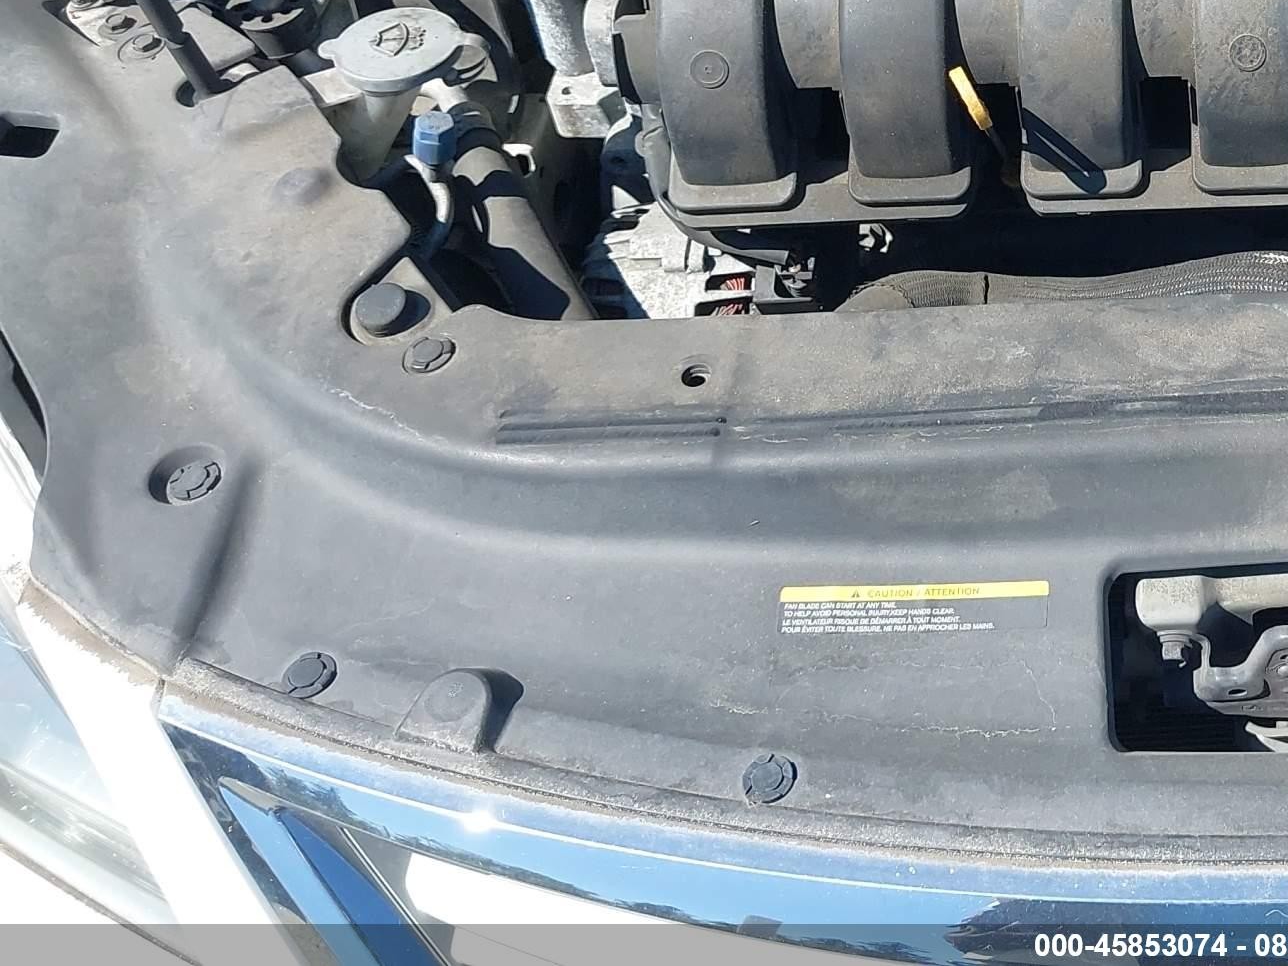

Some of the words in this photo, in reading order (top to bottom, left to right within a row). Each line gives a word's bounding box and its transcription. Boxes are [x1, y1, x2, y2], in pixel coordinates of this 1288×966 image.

[868, 589, 913, 598] CAUTION
[924, 587, 980, 596] ATTENTION
[784, 602, 798, 610] FAN
[799, 602, 820, 610] BLADE
[856, 601, 866, 609] AT
[866, 601, 880, 609] ANY
[782, 618, 792, 626] LE
[792, 618, 834, 626] VENTILATEUR
[834, 617, 859, 625] RISQUE
[912, 616, 931, 624] TOUT
[781, 626, 801, 634] POUR
[824, 625, 847, 633] TOUTE
[908, 624, 918, 632] EN
[917, 623, 959, 632] APPROCHER
